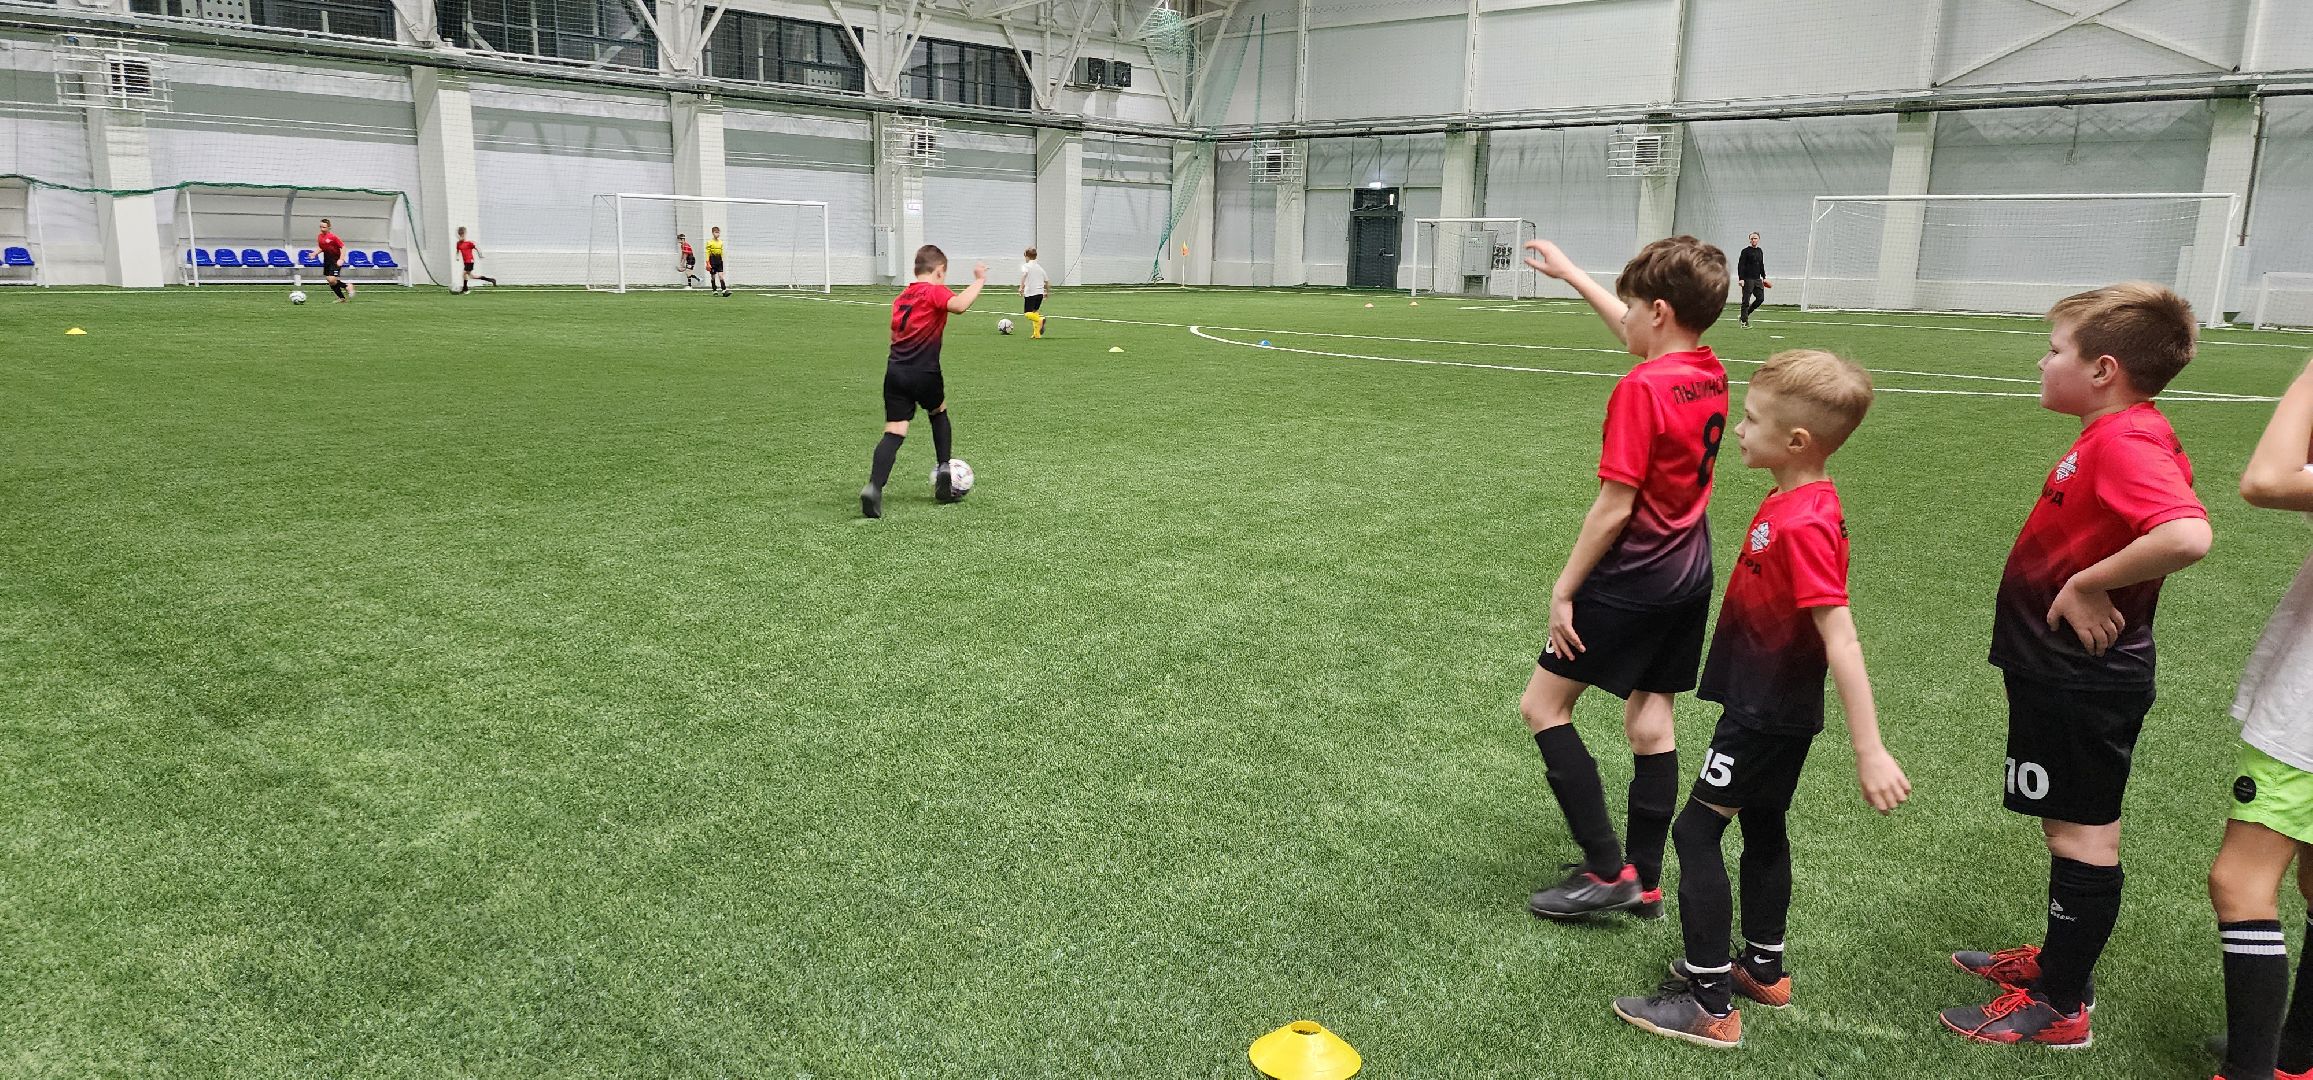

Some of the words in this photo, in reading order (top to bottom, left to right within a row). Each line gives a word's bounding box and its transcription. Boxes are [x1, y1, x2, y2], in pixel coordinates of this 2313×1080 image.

[898, 304, 913, 332] 7
[1697, 412, 1725, 488] 8
[1700, 747, 1735, 787] 15
[2005, 756, 2050, 800] 10
